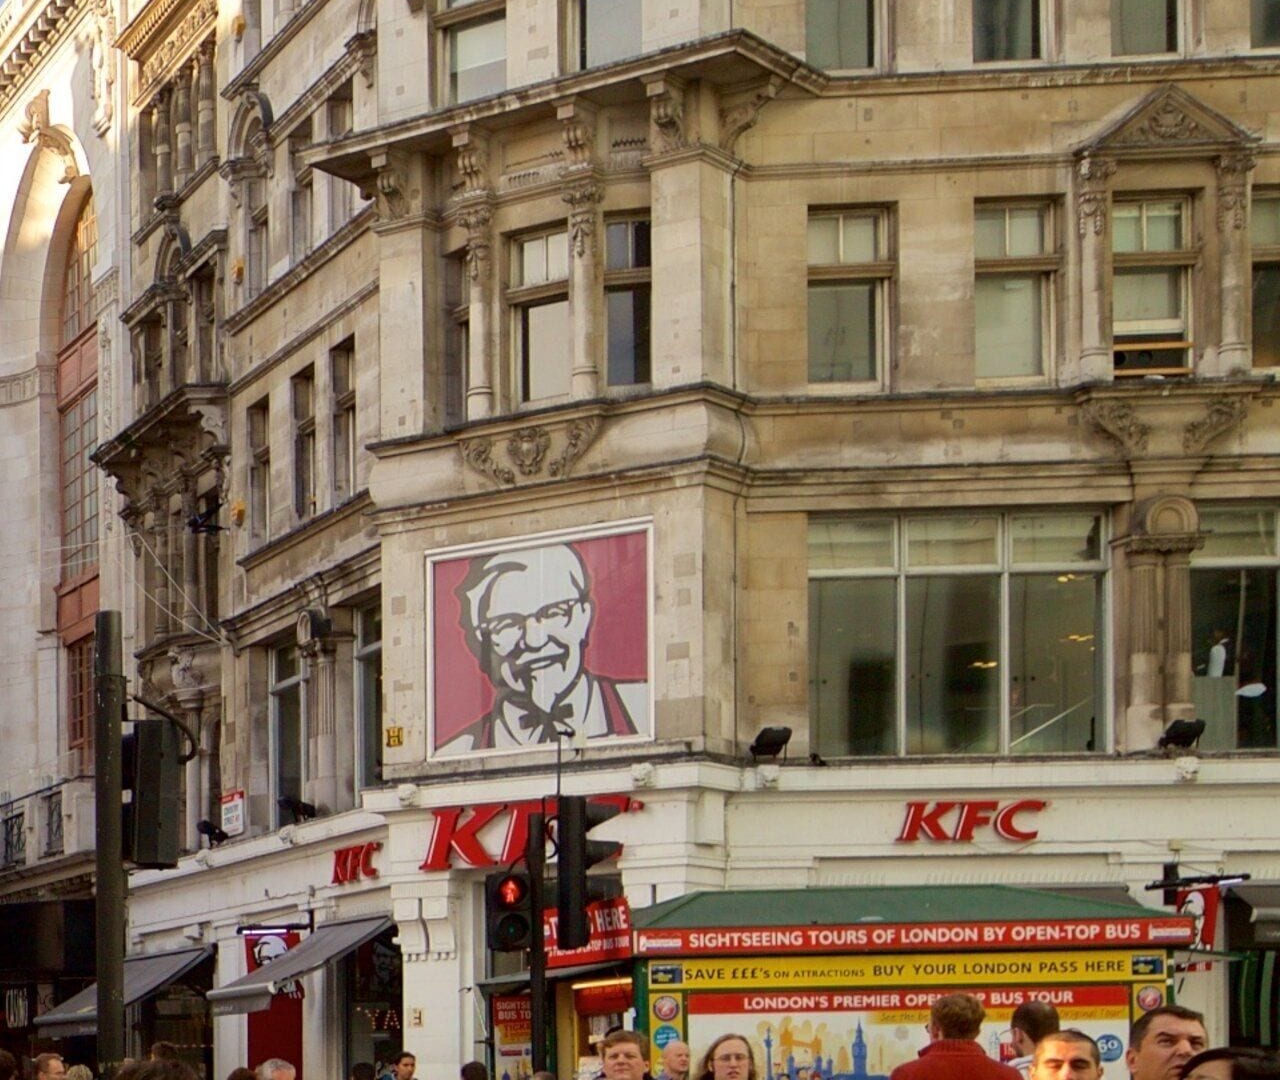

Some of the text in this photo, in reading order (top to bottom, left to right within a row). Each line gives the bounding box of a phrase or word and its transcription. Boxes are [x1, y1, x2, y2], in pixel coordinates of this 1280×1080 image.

[419, 794, 631, 871] KF
[896, 799, 1048, 842] KFC
[331, 841, 381, 884] KFC
[595, 906, 628, 932] HERE
[689, 931, 803, 948] SIGHTSEEING
[808, 929, 867, 946] TOURS
[872, 929, 896, 944] OF
[901, 926, 978, 943] LONDON
[983, 926, 1006, 941] BY
[1011, 924, 1100, 941] OPEN-TOP
[1105, 923, 1140, 939] BUS
[685, 968, 726, 980] SAVE
[793, 969, 865, 978] ATTRACTIONS
[873, 965, 905, 976] BUY
[912, 964, 957, 975] YOUR
[963, 963, 1032, 975] LONDON
[1039, 962, 1078, 973] PASS
[1085, 961, 1125, 972] HERE
[496, 1001, 531, 1010] SIGHTS
[743, 995, 828, 1010] LONDON'S
[833, 993, 900, 1008] PREMIER
[991, 991, 1023, 1005] BUS
[1028, 991, 1074, 1004] TOUR
[498, 1010, 517, 1020] BUS
